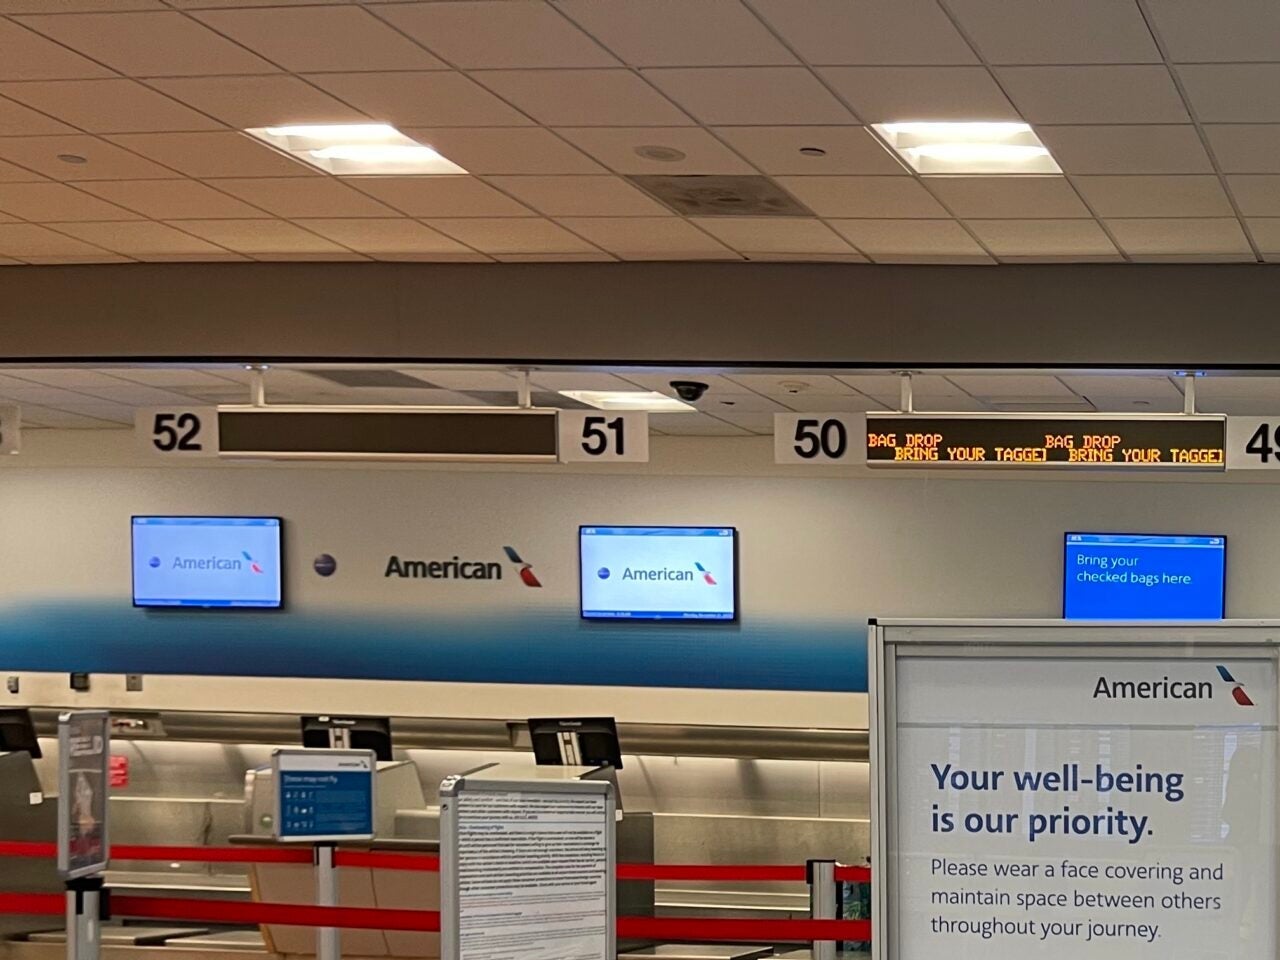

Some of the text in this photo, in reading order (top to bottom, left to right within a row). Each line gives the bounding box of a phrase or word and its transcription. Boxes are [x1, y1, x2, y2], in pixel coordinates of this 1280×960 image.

[152, 412, 202, 452] 52
[581, 416, 624, 456] 51
[793, 419, 847, 458] 50
[868, 433, 942, 448] BAG DROP
[1045, 435, 1121, 449] BAG DROP
[894, 447, 938, 460] BRING
[947, 448, 985, 461] YOUR
[1068, 448, 1113, 462] BRING
[1122, 449, 1161, 462] YOUR
[172, 556, 241, 570] American
[384, 554, 502, 581] American
[1077, 554, 1139, 569] Bring your
[622, 567, 694, 581] American
[1077, 571, 1127, 583] checked
[1130, 572, 1159, 586] bags
[1092, 676, 1213, 699] American
[931, 763, 1185, 802] Your well-being
[931, 804, 1154, 843] is our priority.
[932, 859, 1224, 885] Please wear a face covering and
[932, 888, 1221, 910] maintain space between others
[931, 916, 1162, 943] throughout your journey.
